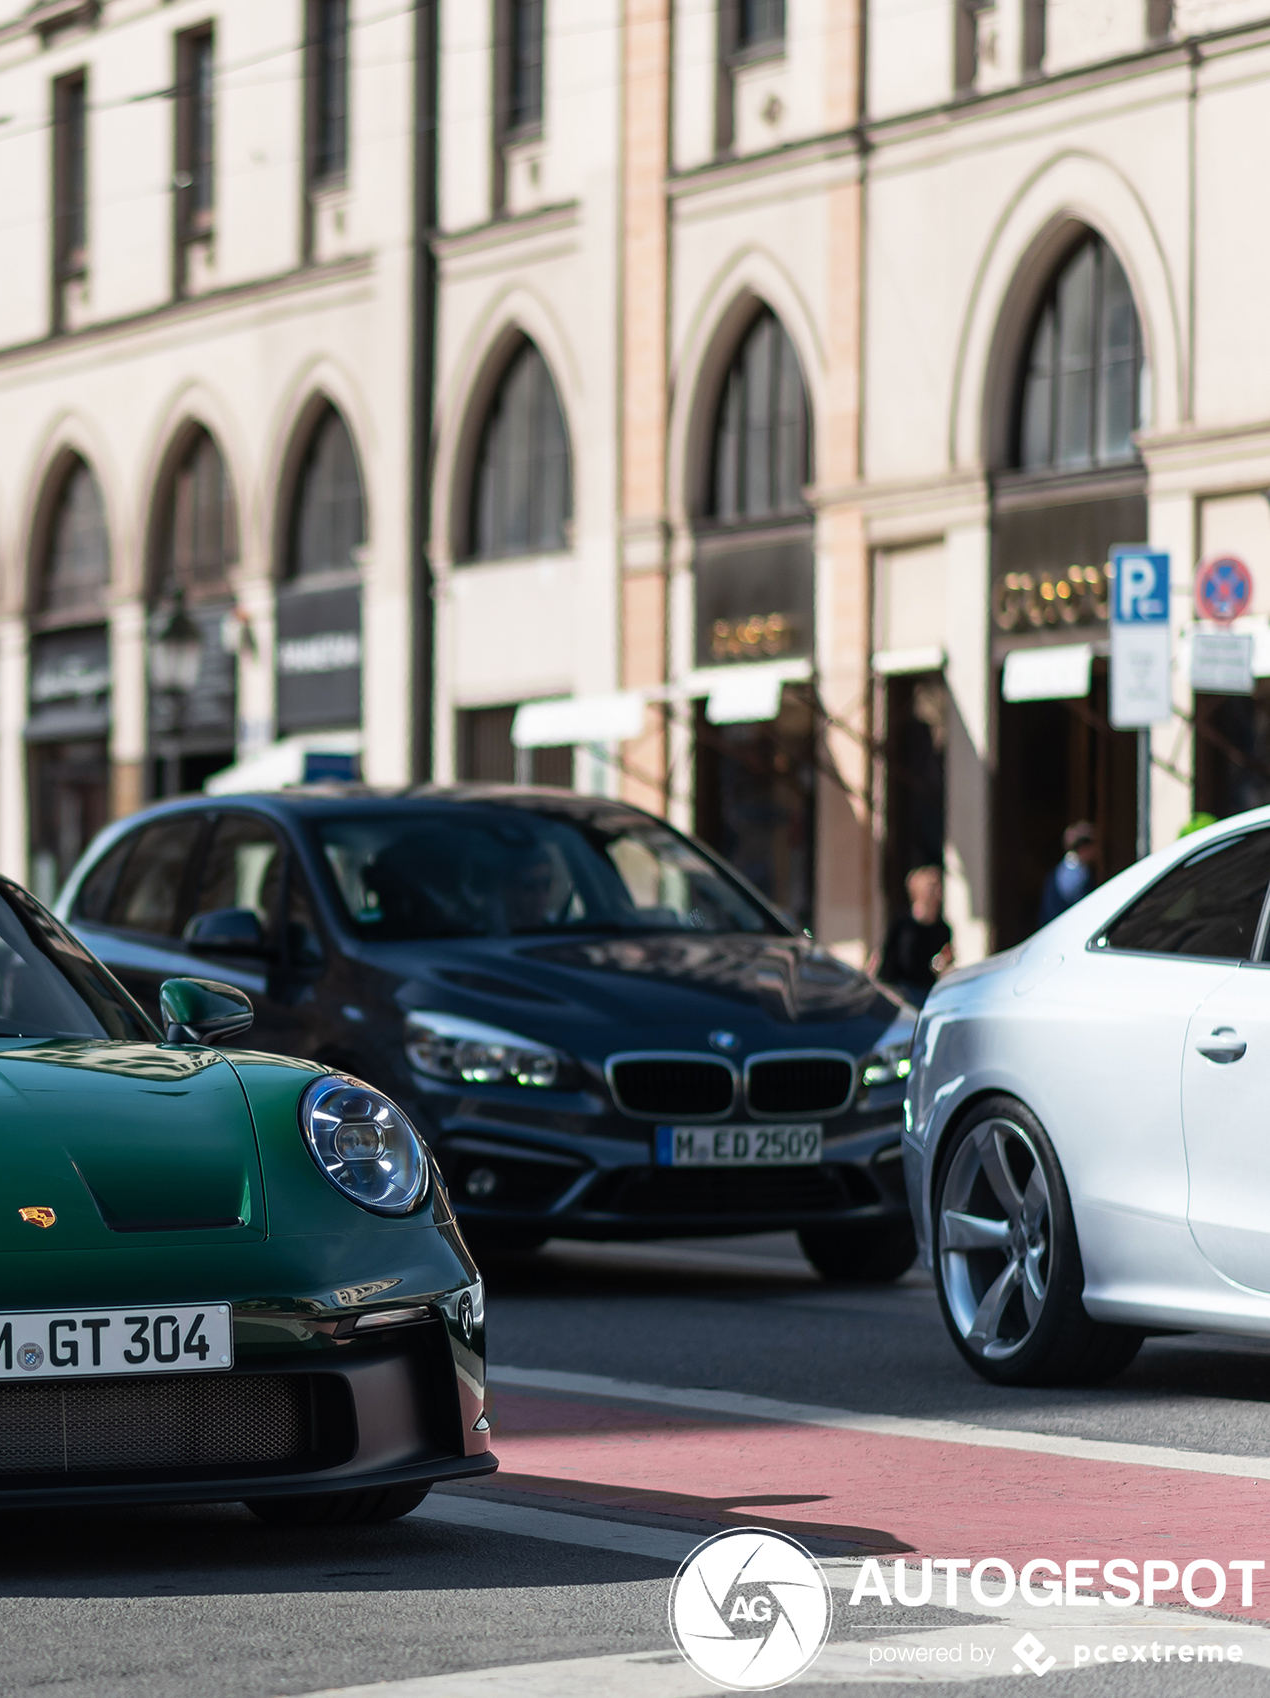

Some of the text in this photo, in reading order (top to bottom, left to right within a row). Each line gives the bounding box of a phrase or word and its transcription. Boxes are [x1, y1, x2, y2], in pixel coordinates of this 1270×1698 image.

[1120, 558, 1157, 621] P
[675, 1131, 819, 1159] M ED 2509
[49, 1318, 111, 1367] GT
[123, 1313, 210, 1364] 304
